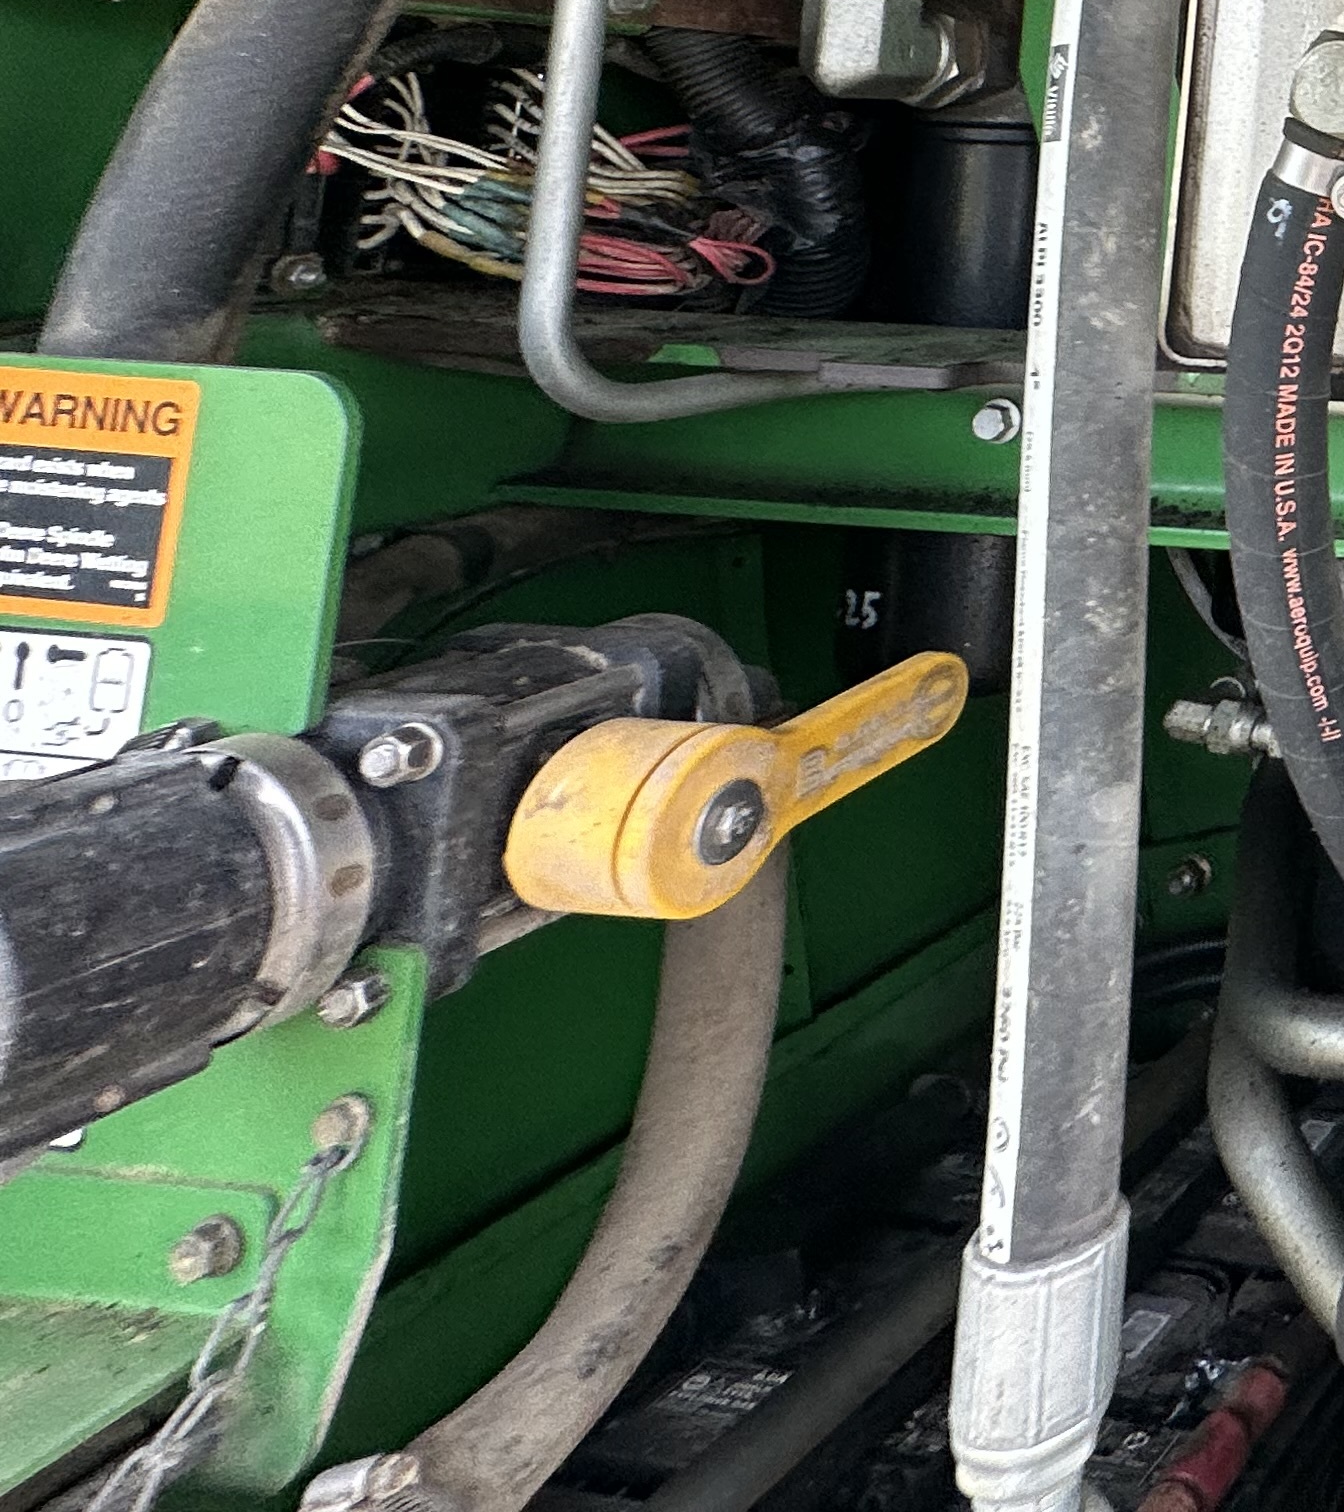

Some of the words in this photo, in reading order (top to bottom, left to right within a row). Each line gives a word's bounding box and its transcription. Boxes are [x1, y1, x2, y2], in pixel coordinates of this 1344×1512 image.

[1289, 232, 1328, 319] IC-84/24
[1279, 324, 1305, 378] 2Q12
[1274, 382, 1299, 447] MADE
[1274, 452, 1295, 477] IN
[1273, 480, 1298, 542] U.S.A.
[1281, 547, 1329, 711] www.aeroquip.com
